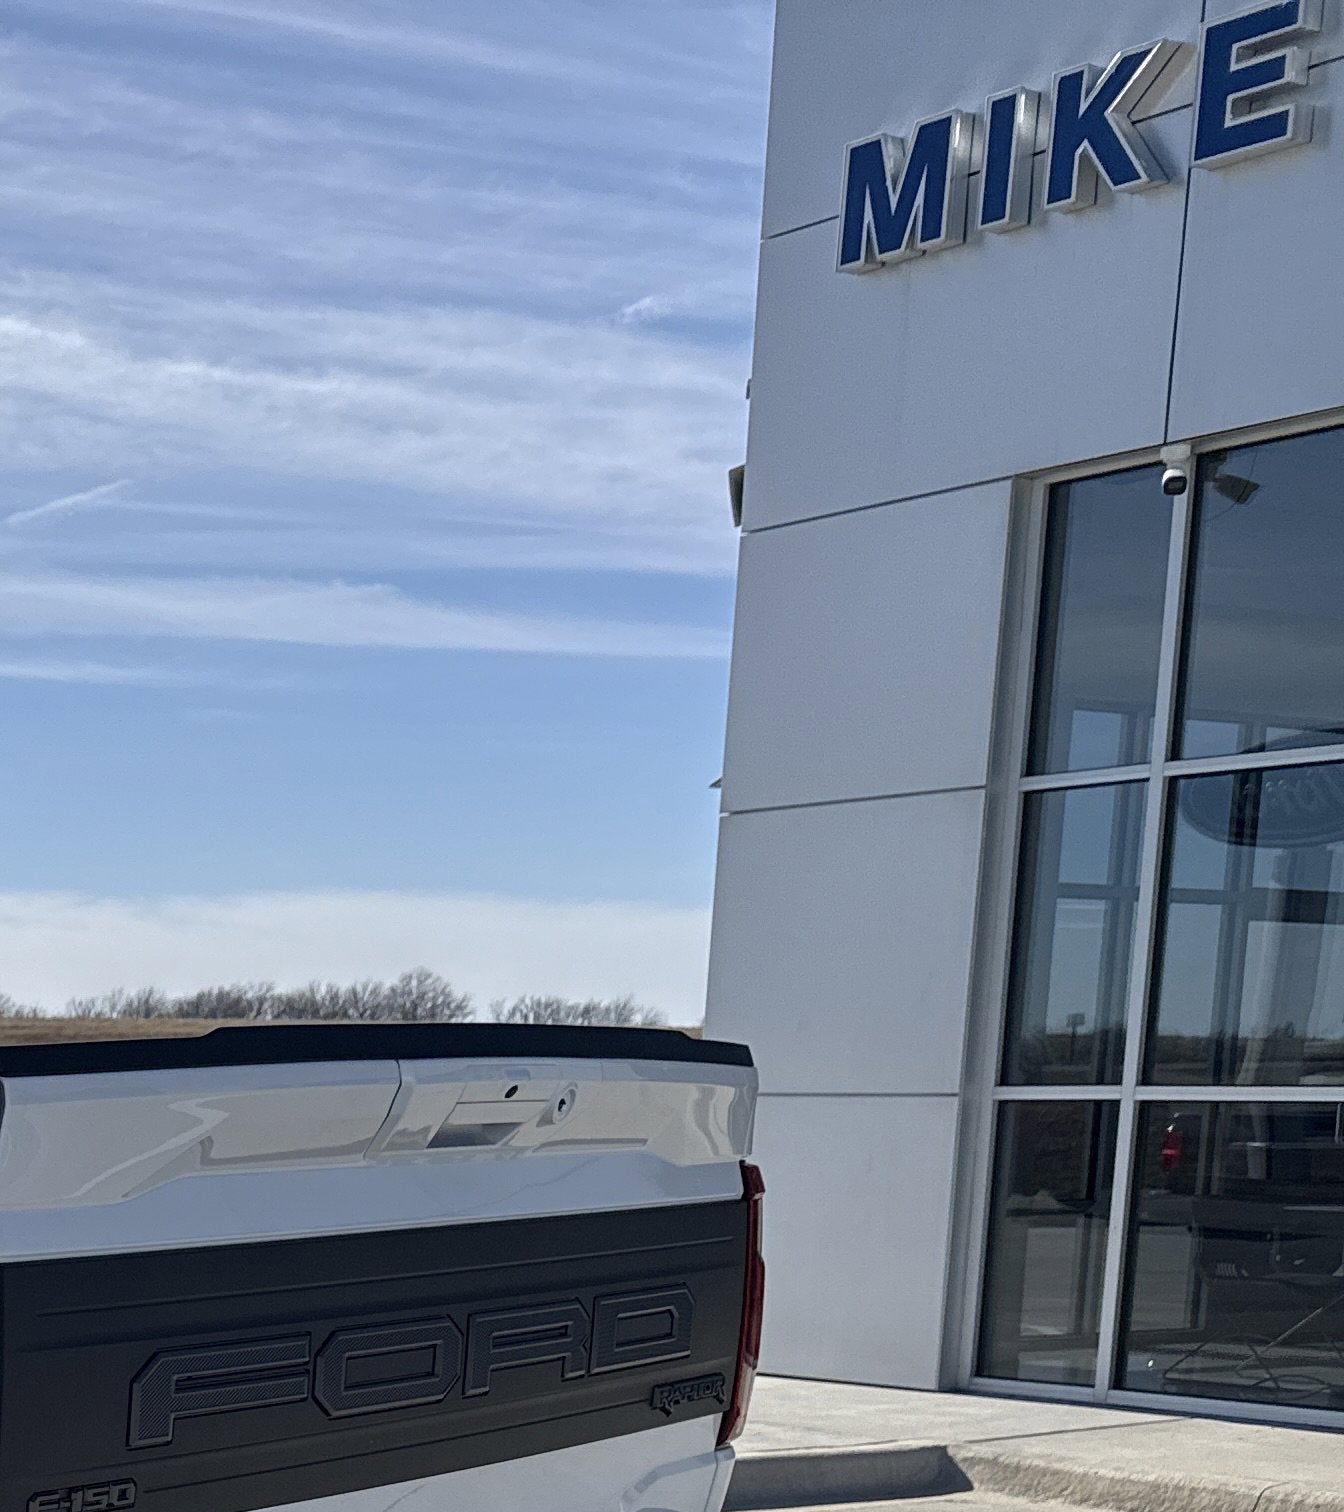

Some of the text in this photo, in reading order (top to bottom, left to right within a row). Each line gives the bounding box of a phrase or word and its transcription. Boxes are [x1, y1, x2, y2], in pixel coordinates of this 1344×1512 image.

[835, 0, 1320, 272] MIKE
[126, 1283, 696, 1450] FORD
[650, 1372, 726, 1417] RAPTOR
